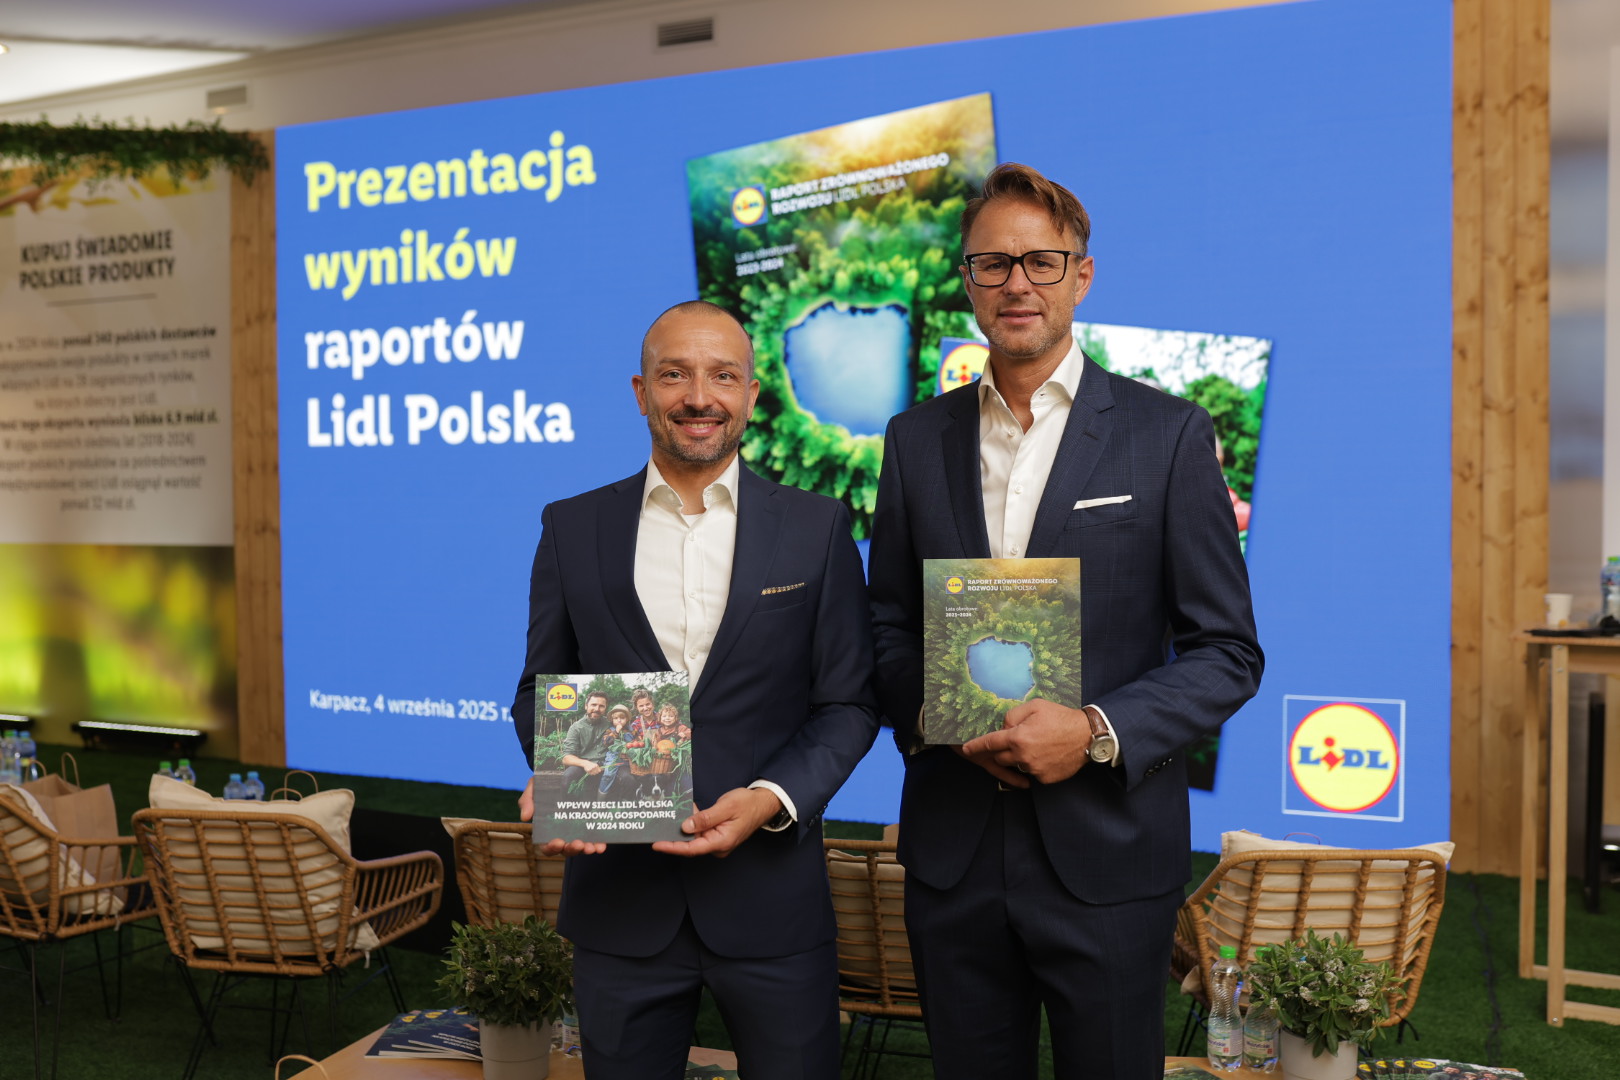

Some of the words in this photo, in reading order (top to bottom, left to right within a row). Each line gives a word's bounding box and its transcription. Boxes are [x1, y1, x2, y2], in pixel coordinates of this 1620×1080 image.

[304, 130, 597, 212] Prezentacja
[770, 178, 820, 200] RAPORT
[820, 152, 950, 191] ZRÓWNOWAŻONEGO
[771, 191, 833, 215] ROZWOJU
[833, 185, 860, 204] LIDL
[861, 176, 907, 200] POLSKA
[20, 241, 72, 263] KUPUJ
[76, 229, 174, 259] ŚWIADOMIE
[20, 266, 83, 290] POLSKIE
[89, 257, 176, 285] PRODUKTY
[304, 227, 517, 301] wyników
[305, 310, 525, 380] raportów
[307, 393, 394, 447] Lidl
[404, 389, 575, 445] Polska
[993, 577, 1058, 585] ZRÓWNOWAŻONEGO
[309, 688, 371, 714] Karpacz,
[373, 693, 385, 713] 4
[387, 697, 455, 719] września
[457, 698, 498, 721] 2025
[554, 811, 568, 820] NA
[569, 811, 614, 821] KRAJOWĄ
[614, 810, 677, 820] GOSPODARKĘ
[557, 800, 591, 810] WPŁYW
[592, 800, 616, 809] SIECI
[617, 800, 638, 809] LIDL
[639, 799, 673, 808] POLSKA
[586, 822, 597, 830] W
[597, 822, 618, 831] 2024
[618, 821, 645, 830] ROKU
